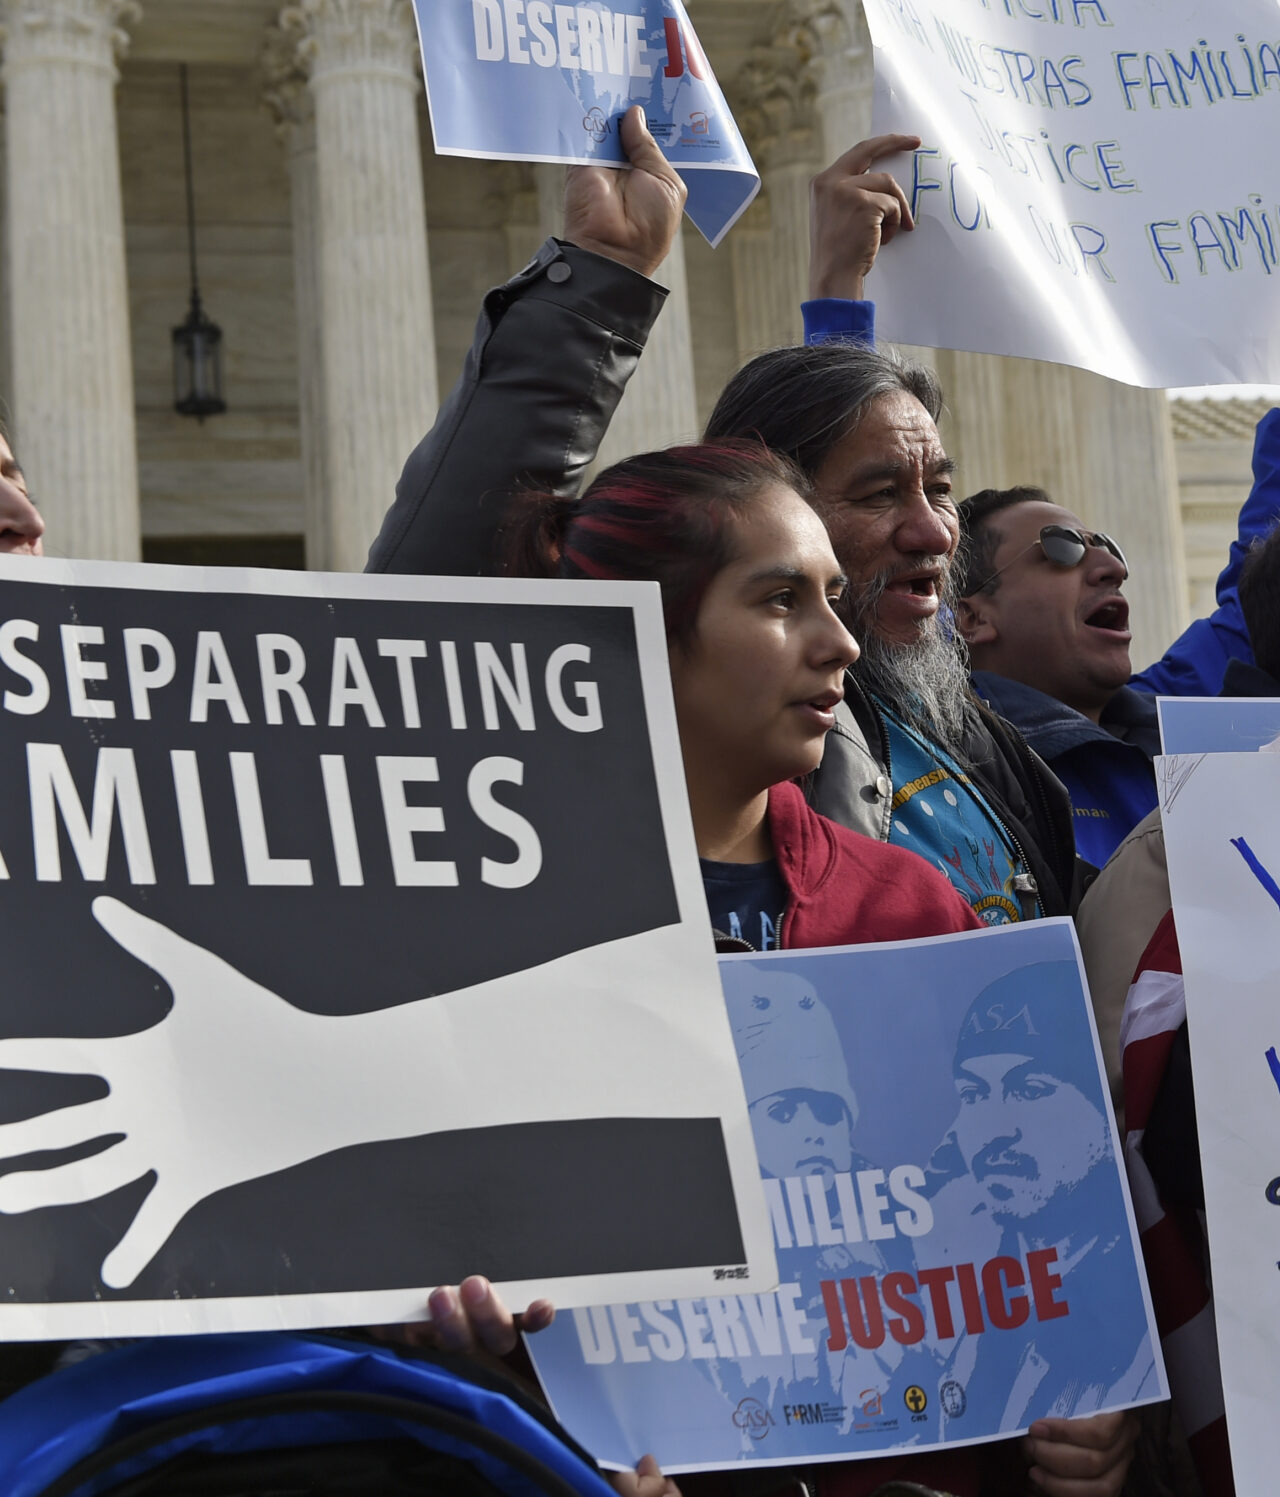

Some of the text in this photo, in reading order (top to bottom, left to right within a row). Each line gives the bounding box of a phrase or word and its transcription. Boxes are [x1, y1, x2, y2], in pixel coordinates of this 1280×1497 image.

[472, 0, 651, 77] DESERVE
[0, 619, 603, 734] SEPARATING
[0, 742, 543, 890] MILIES
[572, 1248, 1070, 1364] DESERVE JUSTICE
